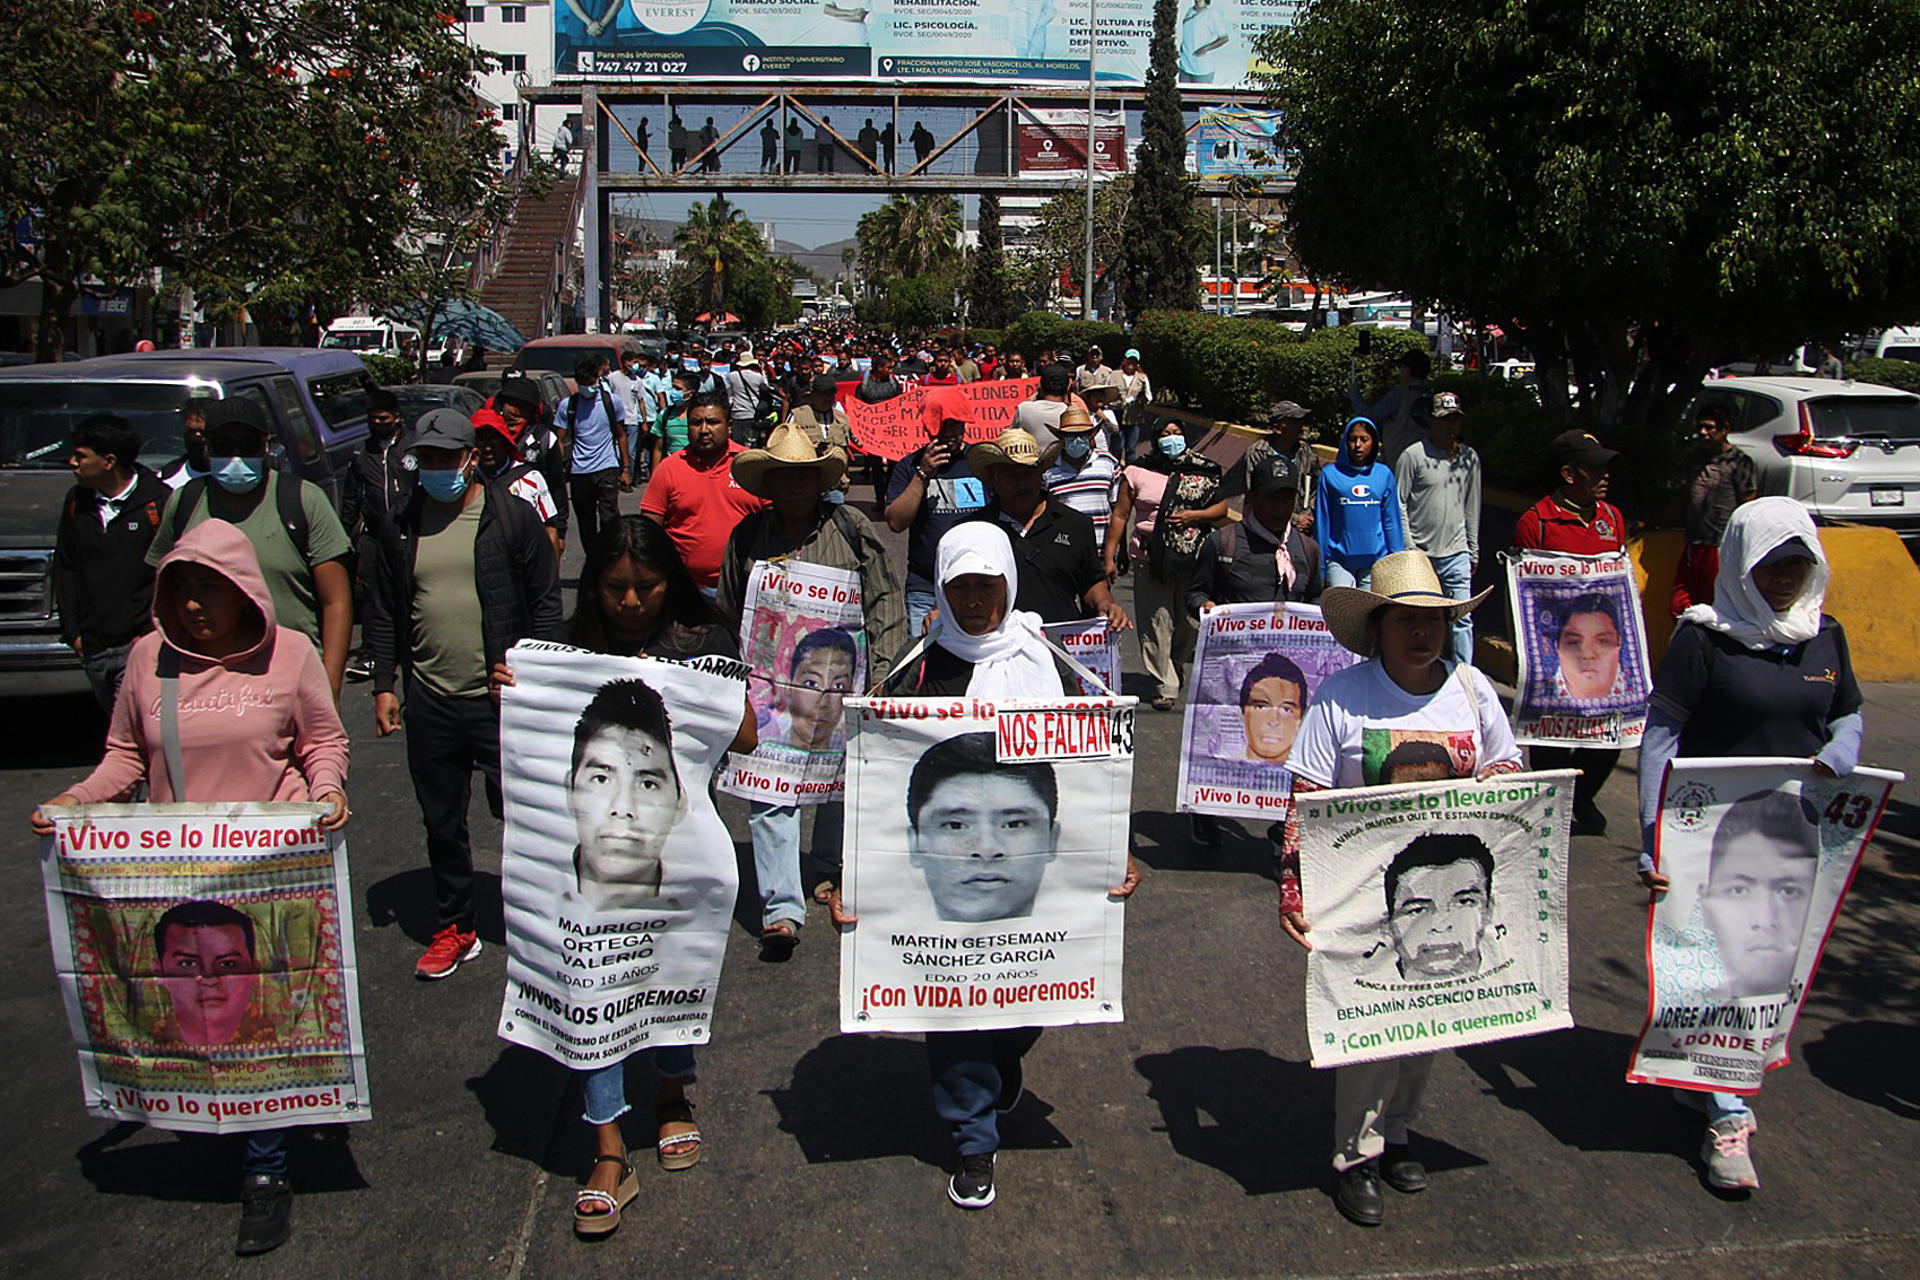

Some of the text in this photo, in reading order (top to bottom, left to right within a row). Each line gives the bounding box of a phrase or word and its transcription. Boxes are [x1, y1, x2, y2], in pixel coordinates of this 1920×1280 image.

[646, 8, 696, 18] EVEREST
[1069, 18, 1088, 26] LIC.
[893, 21, 978, 30] LIC. PSICOLOGÍA.
[1240, 23, 1259, 31] LIC.
[596, 51, 685, 59] Para más información
[596, 62, 687, 73] 747 47 21 027
[1518, 559, 1555, 578] ¡Vivo
[1559, 563, 1576, 576] se
[761, 572, 847, 603] ¡Vivo se lo
[1210, 616, 1245, 636] ¡Vivo
[1250, 617, 1266, 631] se
[1271, 614, 1284, 630] lo
[937, 702, 964, 721] se
[973, 698, 995, 721] lo
[999, 707, 1134, 757] NOS FALTAN 43
[733, 769, 770, 791] ¡Vivo
[775, 777, 789, 794] lo
[1195, 787, 1232, 804] ¡Vivo
[1237, 790, 1250, 805] lo
[1326, 783, 1540, 818] ¡Vivo se lo llevaron!
[1823, 791, 1874, 829] 43
[59, 823, 326, 855] ¡Vivo se lo llevaron!
[1332, 826, 1364, 850] NUNCA
[1364, 813, 1405, 831] OLVIDES
[1406, 812, 1428, 822] QUE
[1431, 811, 1443, 820] TE
[1445, 811, 1488, 820] ESTAMOS
[558, 917, 667, 937] MAURICIO
[563, 933, 654, 953] ORTEGA
[891, 931, 1068, 950] MARTÍN GETSEMANY
[561, 948, 654, 970] VALERIO
[902, 949, 1056, 967] SÁNCHEZ GARCÍA
[556, 963, 660, 989] EDAD 18 AÑOS
[925, 969, 1039, 984] EDAD 20 AÑOS
[1353, 978, 1387, 992] NUNCA
[1433, 981, 1456, 990] QUE
[518, 982, 707, 1026] ¡VIVOS LOS QUEREMOS!
[862, 977, 1096, 1011] ¡Con VIDA lo queremos!
[1337, 981, 1538, 1021] BENJAMÍN ASCENCIO BAUTISTA
[515, 1008, 542, 1027] CONTRA
[542, 1020, 550, 1032] EL
[598, 1034, 610, 1045] DE
[640, 1017, 649, 1028] LA
[650, 1012, 708, 1025] SOLIDARIDAD
[1655, 1006, 1755, 1031] JORGE ANTONIO
[1341, 1005, 1538, 1055] ¡Con VIDA lo queremos!
[108, 1055, 140, 1073] JOSÉ
[152, 1058, 199, 1074] ÁNGEL
[207, 1060, 267, 1075] CAMPOS
[277, 1055, 335, 1071] CANTOR
[115, 1087, 342, 1122] ¡Vivo lo queremos!
